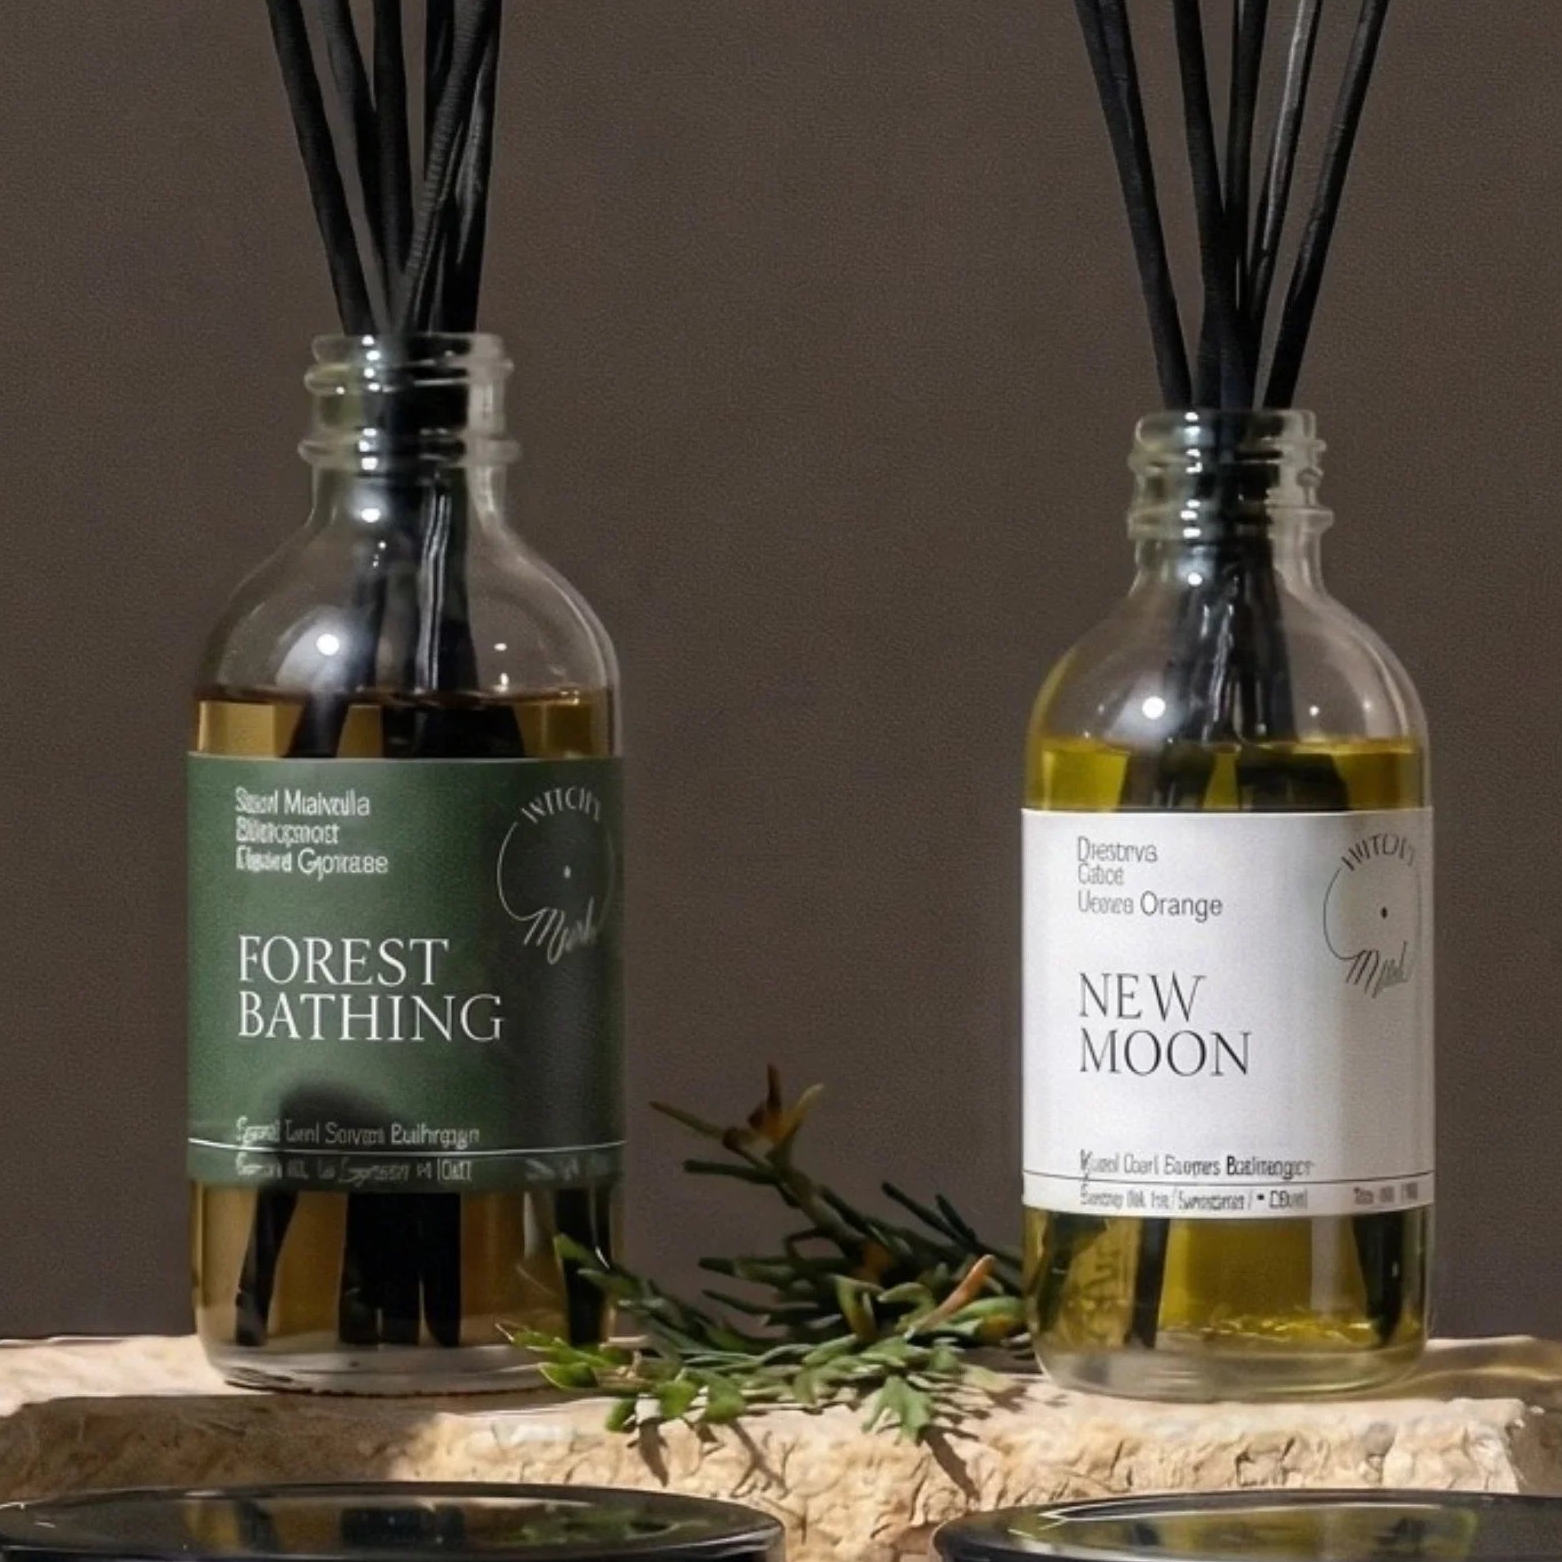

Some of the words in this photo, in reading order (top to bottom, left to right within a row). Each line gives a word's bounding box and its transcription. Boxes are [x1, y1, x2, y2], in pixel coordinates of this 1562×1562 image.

[1140, 890, 1223, 923] Orange
[238, 935, 450, 987] FOREST
[238, 991, 505, 1042] BATHING
[1079, 971, 1206, 1022] NEW
[1079, 1027, 1252, 1076] MOON
